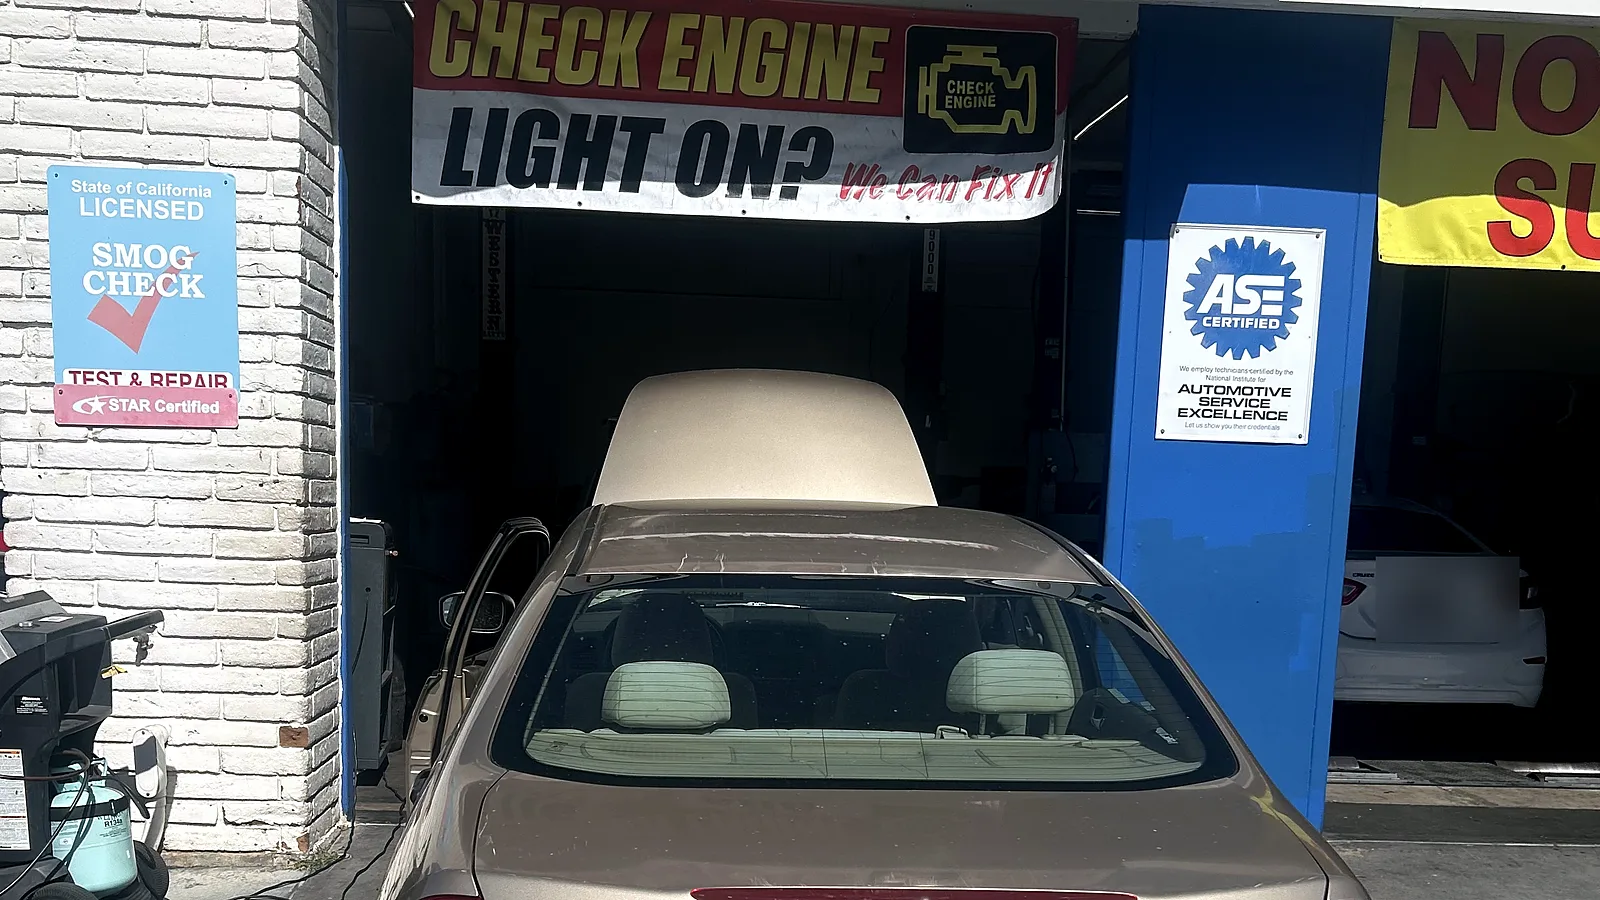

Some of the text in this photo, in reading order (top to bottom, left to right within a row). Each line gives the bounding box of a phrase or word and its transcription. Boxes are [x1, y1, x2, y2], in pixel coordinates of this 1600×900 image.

[428, 0, 891, 103] CHECK ENGINE
[946, 79, 995, 95] CHECK
[1408, 30, 1600, 136] NO
[945, 95, 996, 109] ENGINE
[440, 107, 835, 202] LIGHT ON?
[71, 179, 212, 198] State of California
[839, 161, 1054, 202] We Can Fix It
[79, 197, 205, 221] LICENSED
[92, 242, 195, 270] SMOG
[927, 229, 936, 275] 9000
[82, 271, 205, 299] CHECK
[1196, 273, 1285, 316] ASE
[1202, 316, 1280, 329] CERTIFIED
[68, 370, 228, 389] TEST & REPAIR
[1190, 366, 1214, 374] employ
[1177, 383, 1292, 398] AUTOMOTIVE
[108, 398, 220, 414] STAR Certified
[1198, 396, 1271, 409] SERVICE
[1177, 407, 1289, 421] EXCELLENCE
